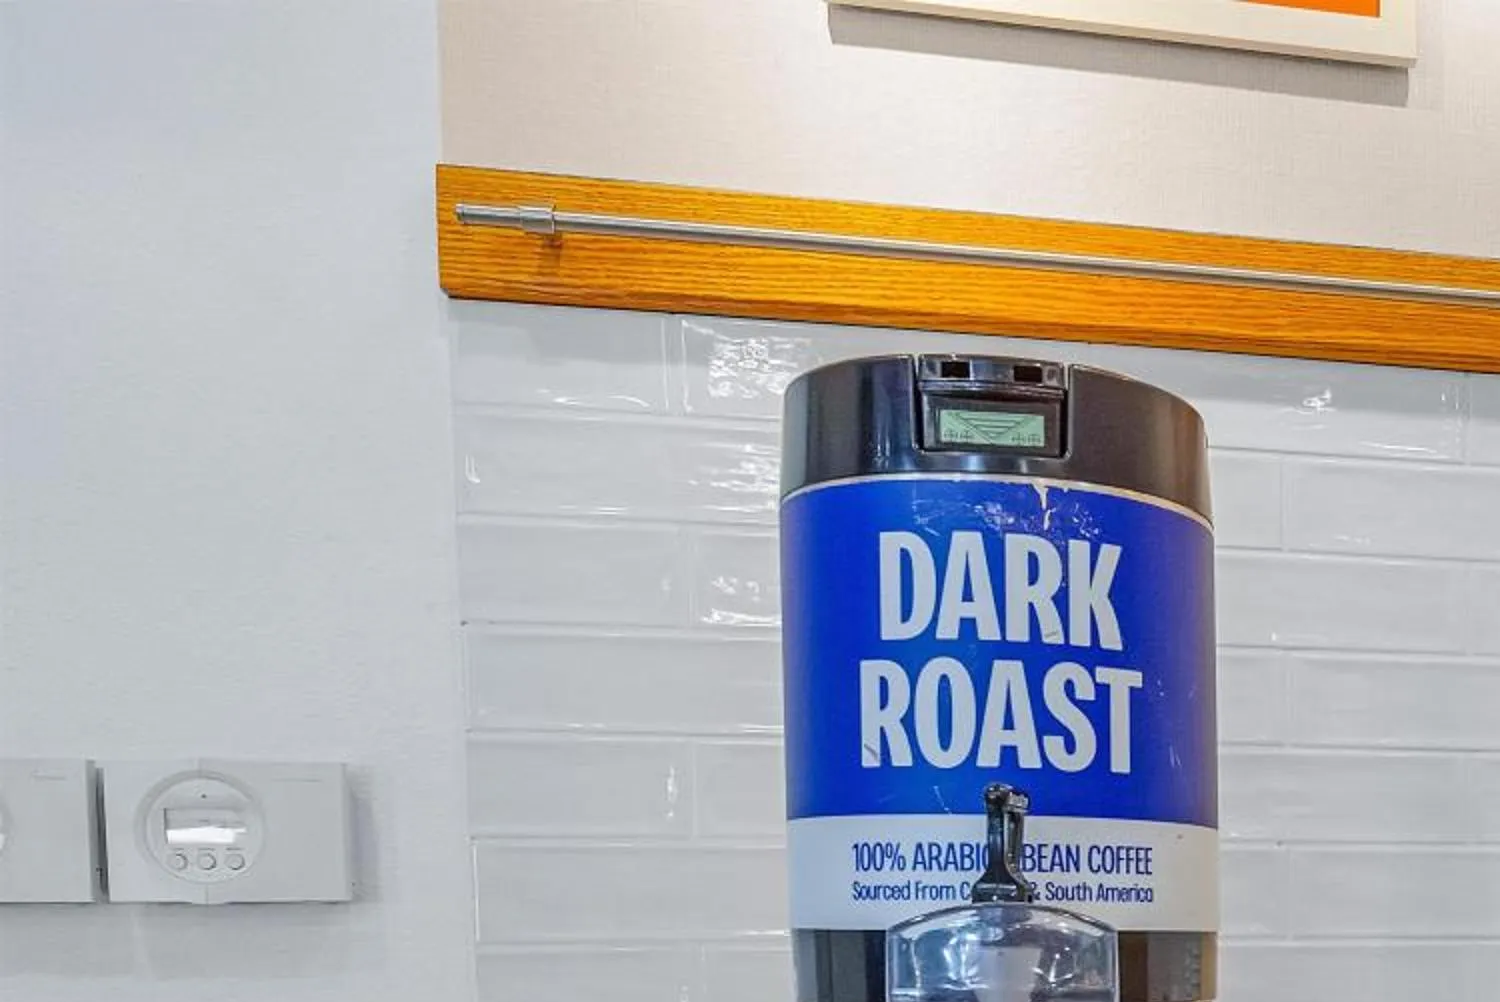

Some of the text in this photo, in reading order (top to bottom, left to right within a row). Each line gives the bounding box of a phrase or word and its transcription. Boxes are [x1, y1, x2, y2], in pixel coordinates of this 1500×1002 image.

[879, 531, 1123, 651] DARK
[860, 657, 1143, 774] ROAST
[852, 842, 1153, 875] 100% ARABIC BEAN COFFEE
[853, 880, 911, 901] Sourced
[915, 882, 956, 901] From
[1045, 881, 1093, 901] South
[1095, 883, 1153, 903] America
